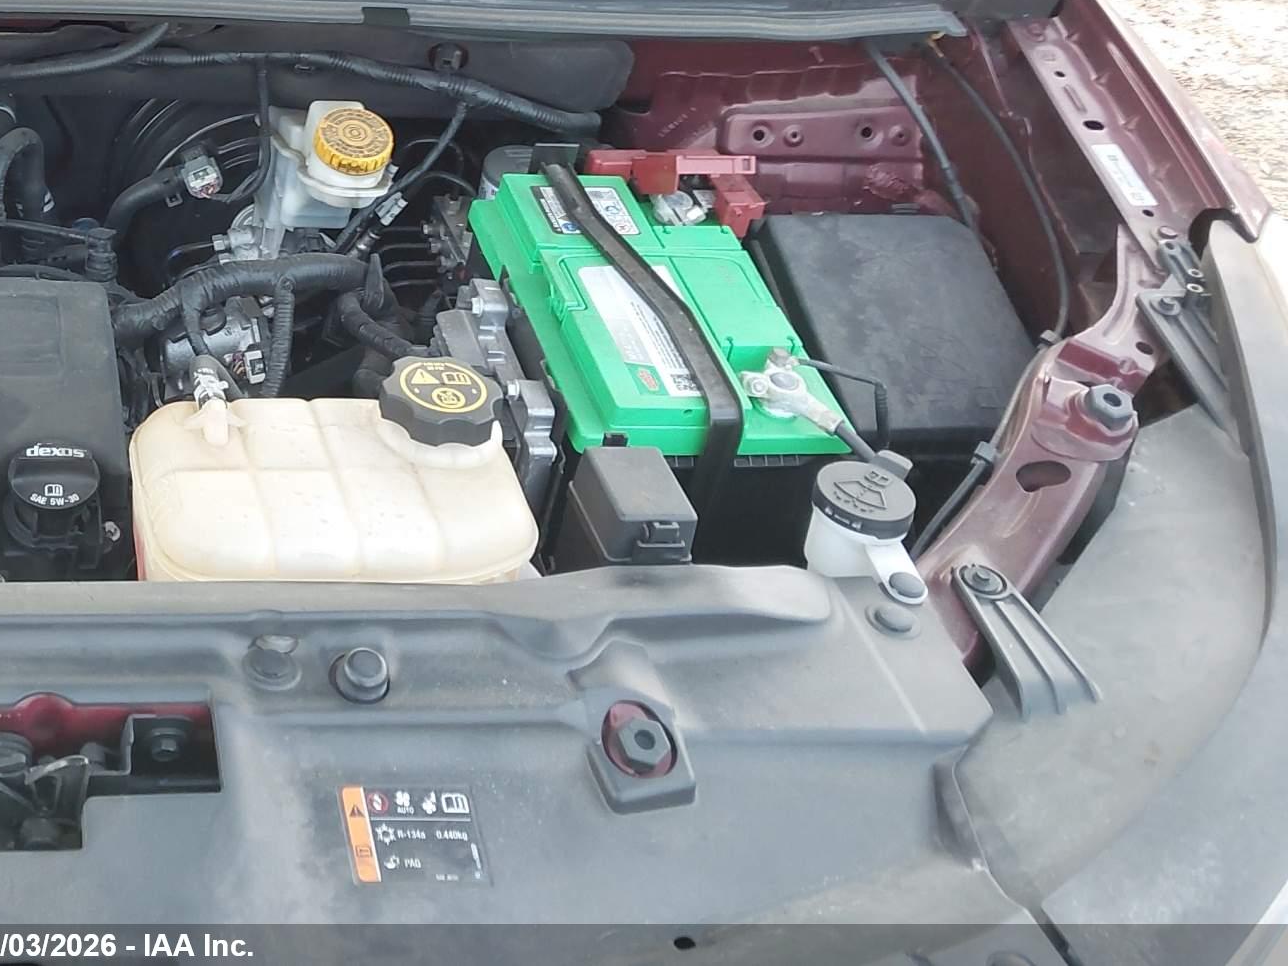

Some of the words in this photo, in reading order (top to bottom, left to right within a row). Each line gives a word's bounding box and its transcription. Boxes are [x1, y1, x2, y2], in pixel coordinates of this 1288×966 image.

[26, 444, 86, 458] dexos
[30, 493, 48, 505] SAE
[50, 493, 80, 507] 5W-30
[397, 806, 415, 814] AUTO
